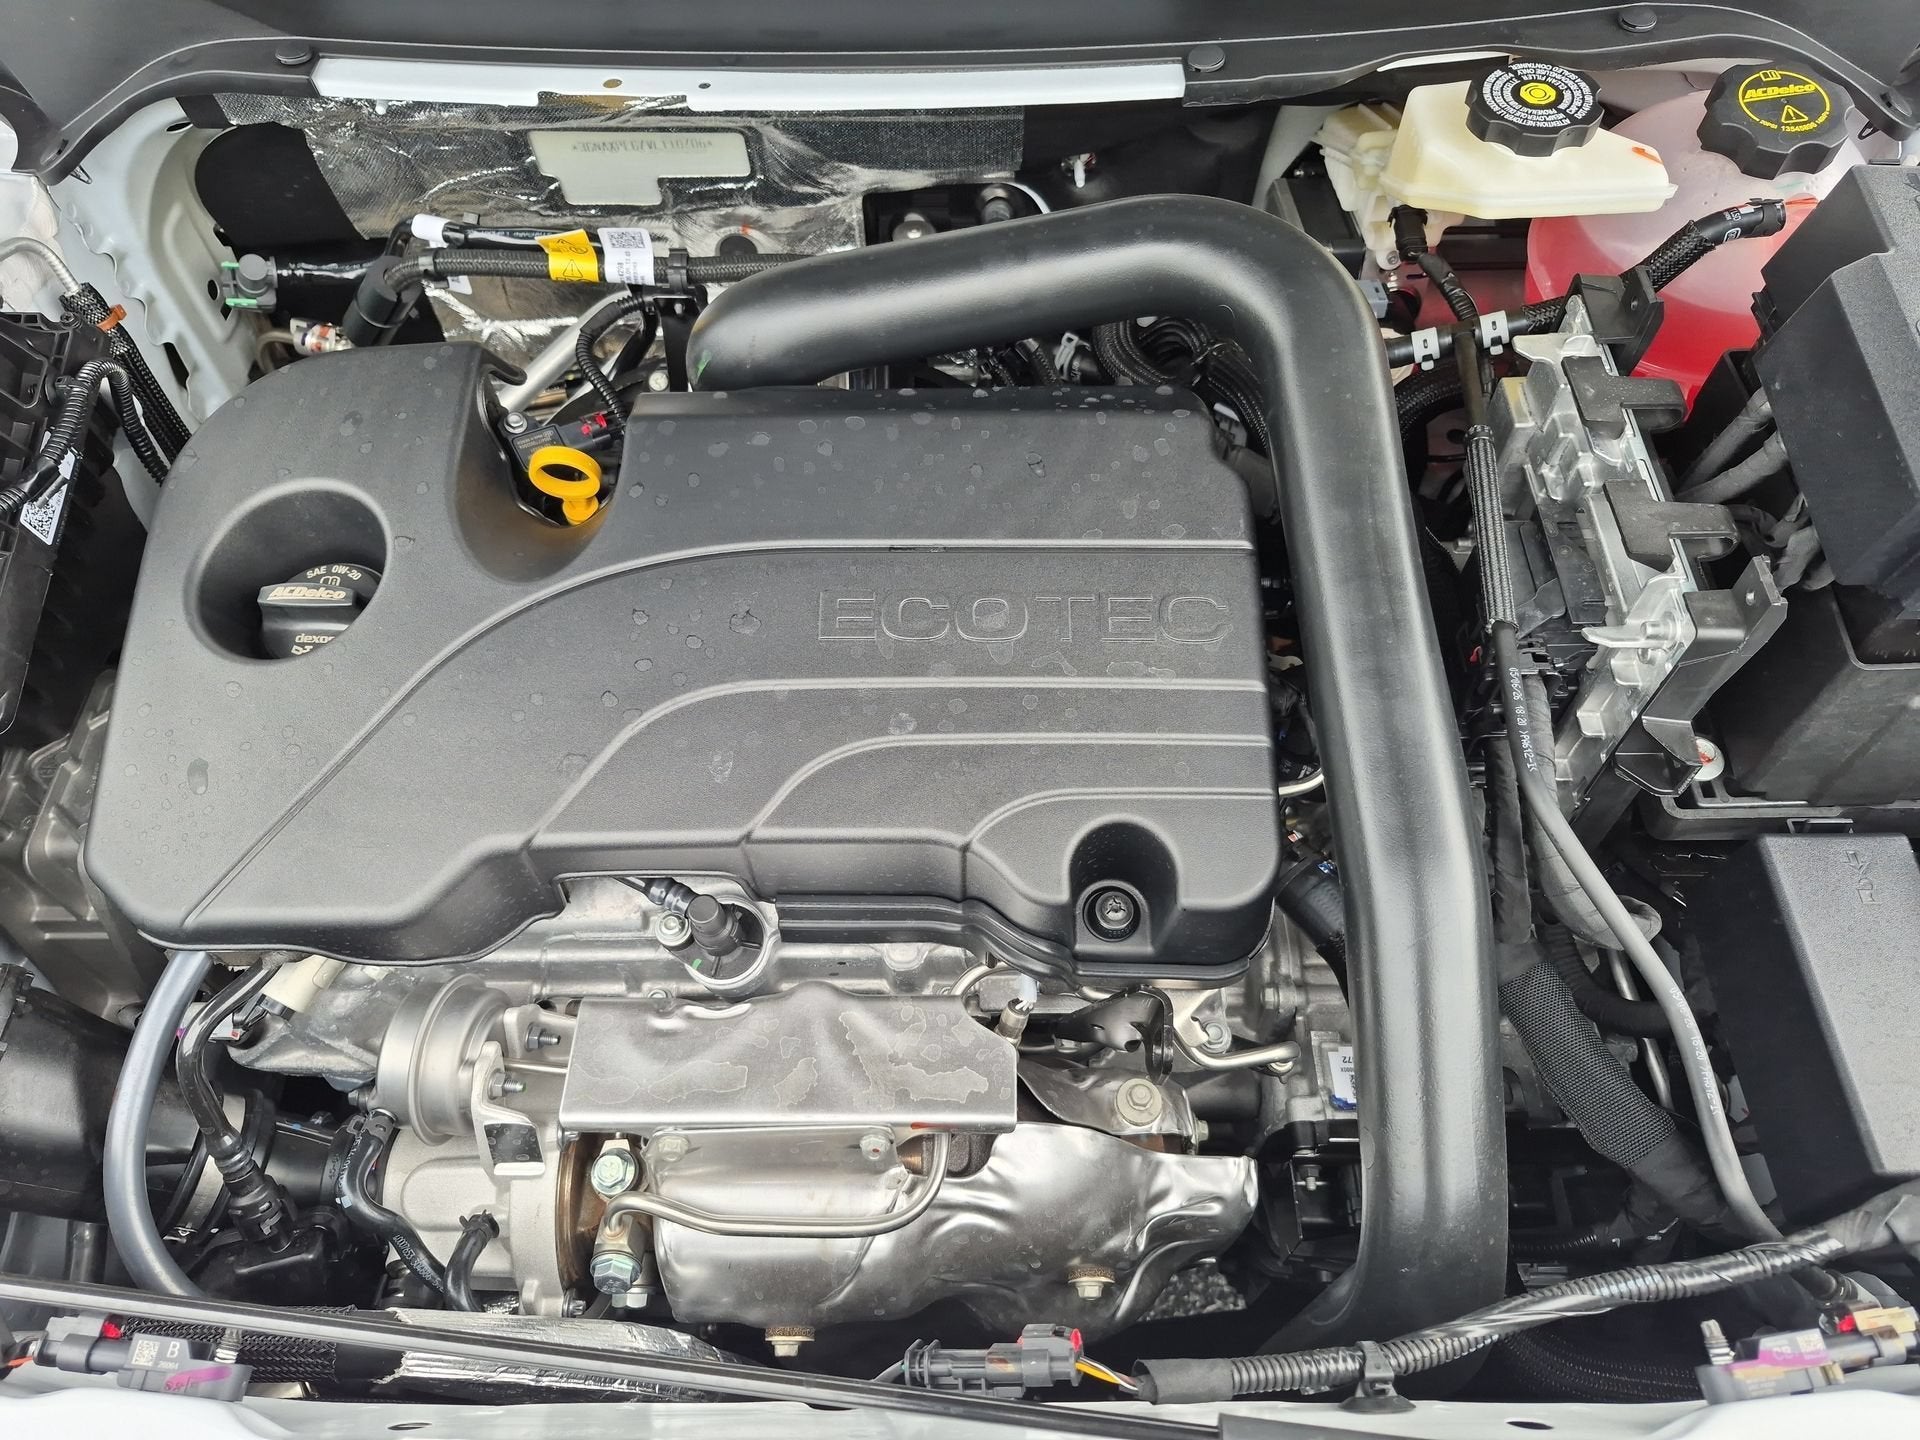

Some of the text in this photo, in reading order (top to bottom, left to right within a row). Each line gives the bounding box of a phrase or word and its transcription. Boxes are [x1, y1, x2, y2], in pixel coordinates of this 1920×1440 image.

[1515, 68, 1535, 76] ONLY
[1552, 66, 1579, 80] SEALED
[1744, 84, 1816, 99] ACDelco
[1503, 113, 1535, 127] NETTOYER
[306, 565, 362, 581] SAE 0W-20
[269, 586, 347, 600] ACDelco
[817, 590, 1235, 643] ECOTEC
[1515, 705, 1527, 726] 18:20
[167, 1341, 180, 1358] B
